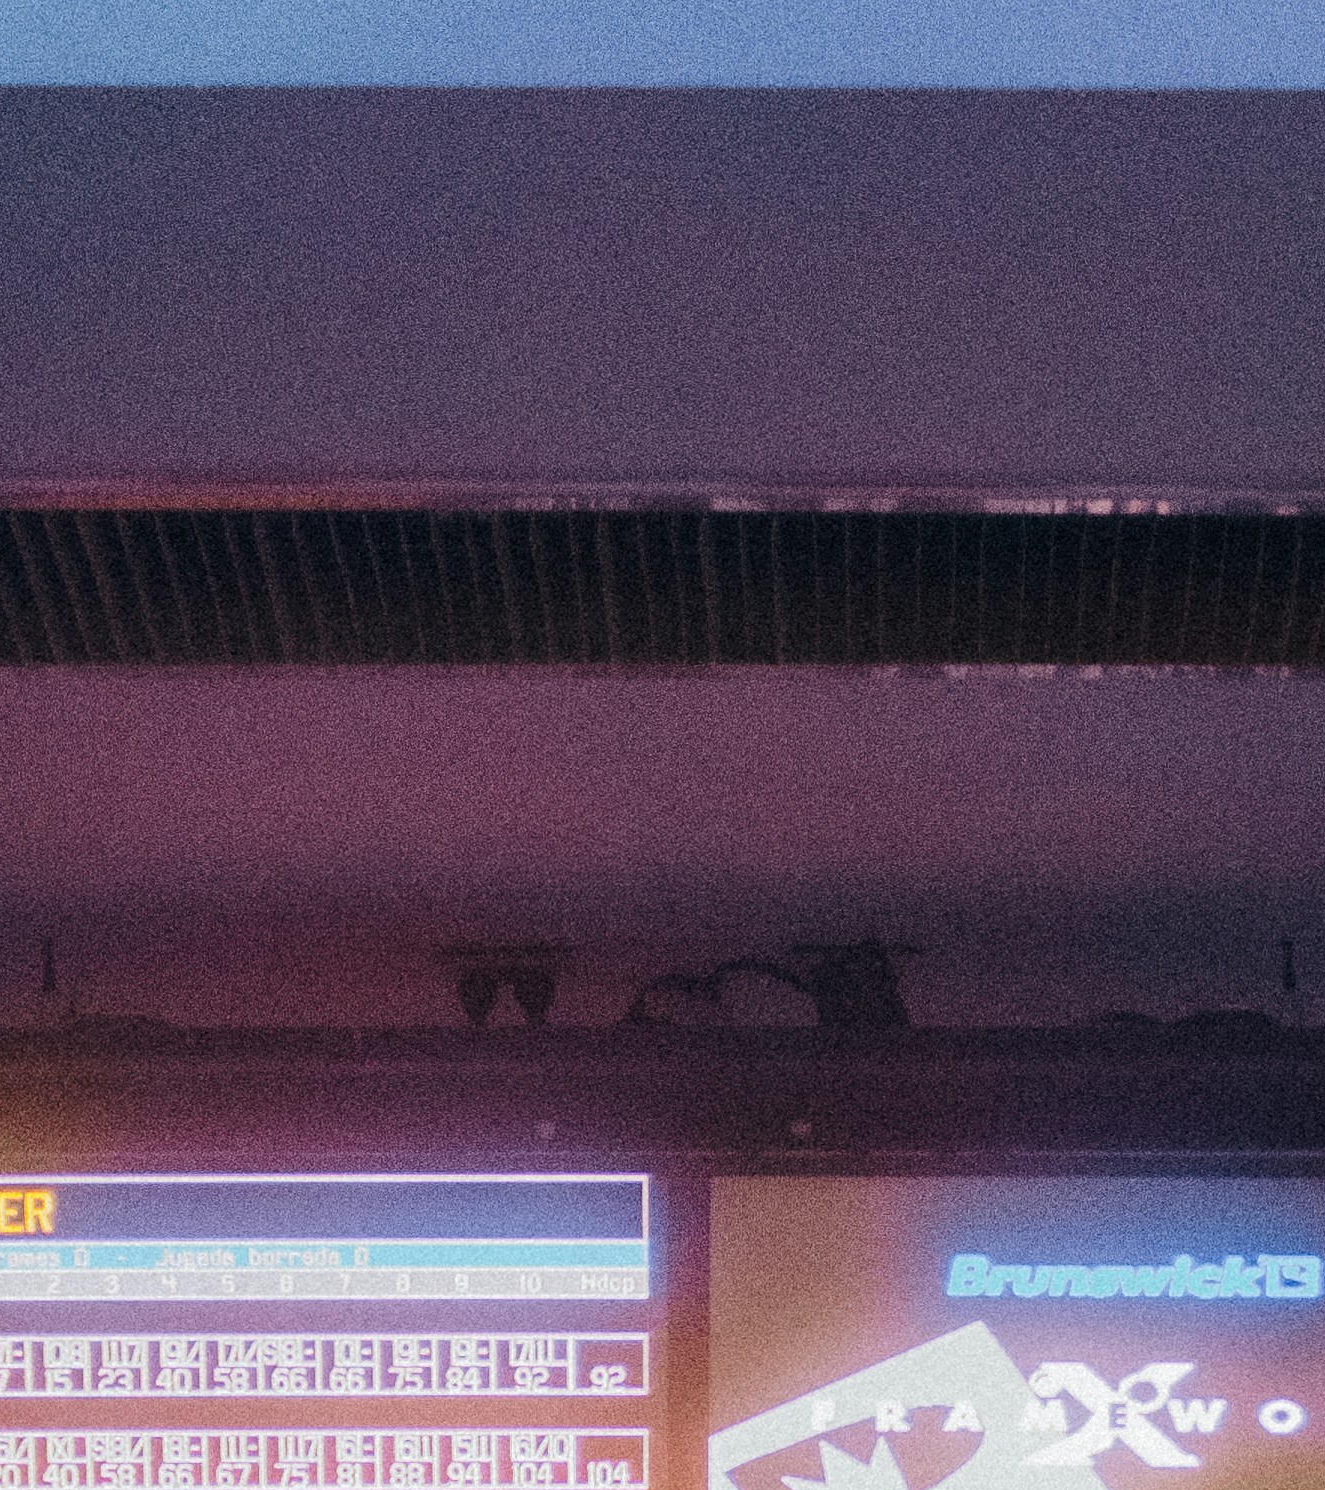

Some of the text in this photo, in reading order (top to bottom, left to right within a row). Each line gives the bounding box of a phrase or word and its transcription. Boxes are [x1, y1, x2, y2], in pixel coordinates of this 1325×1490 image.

[47, 1274, 62, 1294] 2
[105, 1275, 120, 1293] 3
[161, 1274, 176, 1293] 4
[222, 1274, 236, 1293] 5
[396, 1273, 411, 1293] 8
[454, 1273, 469, 1292] 9
[520, 1273, 543, 1293] 10
[946, 1254, 1262, 1299] Brunswick
[45, 1368, 72, 1391] 15
[98, 1368, 134, 1391] 23
[156, 1367, 192, 1391] 40
[213, 1367, 249, 1391] 58
[271, 1367, 308, 1391] 66
[329, 1367, 366, 1391] 66
[388, 1366, 424, 1390] 75
[445, 1366, 481, 1390] 84
[513, 1366, 550, 1390] 92
[589, 1365, 626, 1390] 92
[43, 1464, 79, 1487] 40
[100, 1463, 136, 1487] 58
[158, 1463, 194, 1487] 66
[216, 1463, 252, 1487] 67
[274, 1463, 309, 1486] 75
[336, 1463, 363, 1486] 81
[389, 1462, 425, 1485] 88
[447, 1462, 481, 1485] 94
[513, 1462, 552, 1486] 104
[587, 1461, 628, 1485] 104
